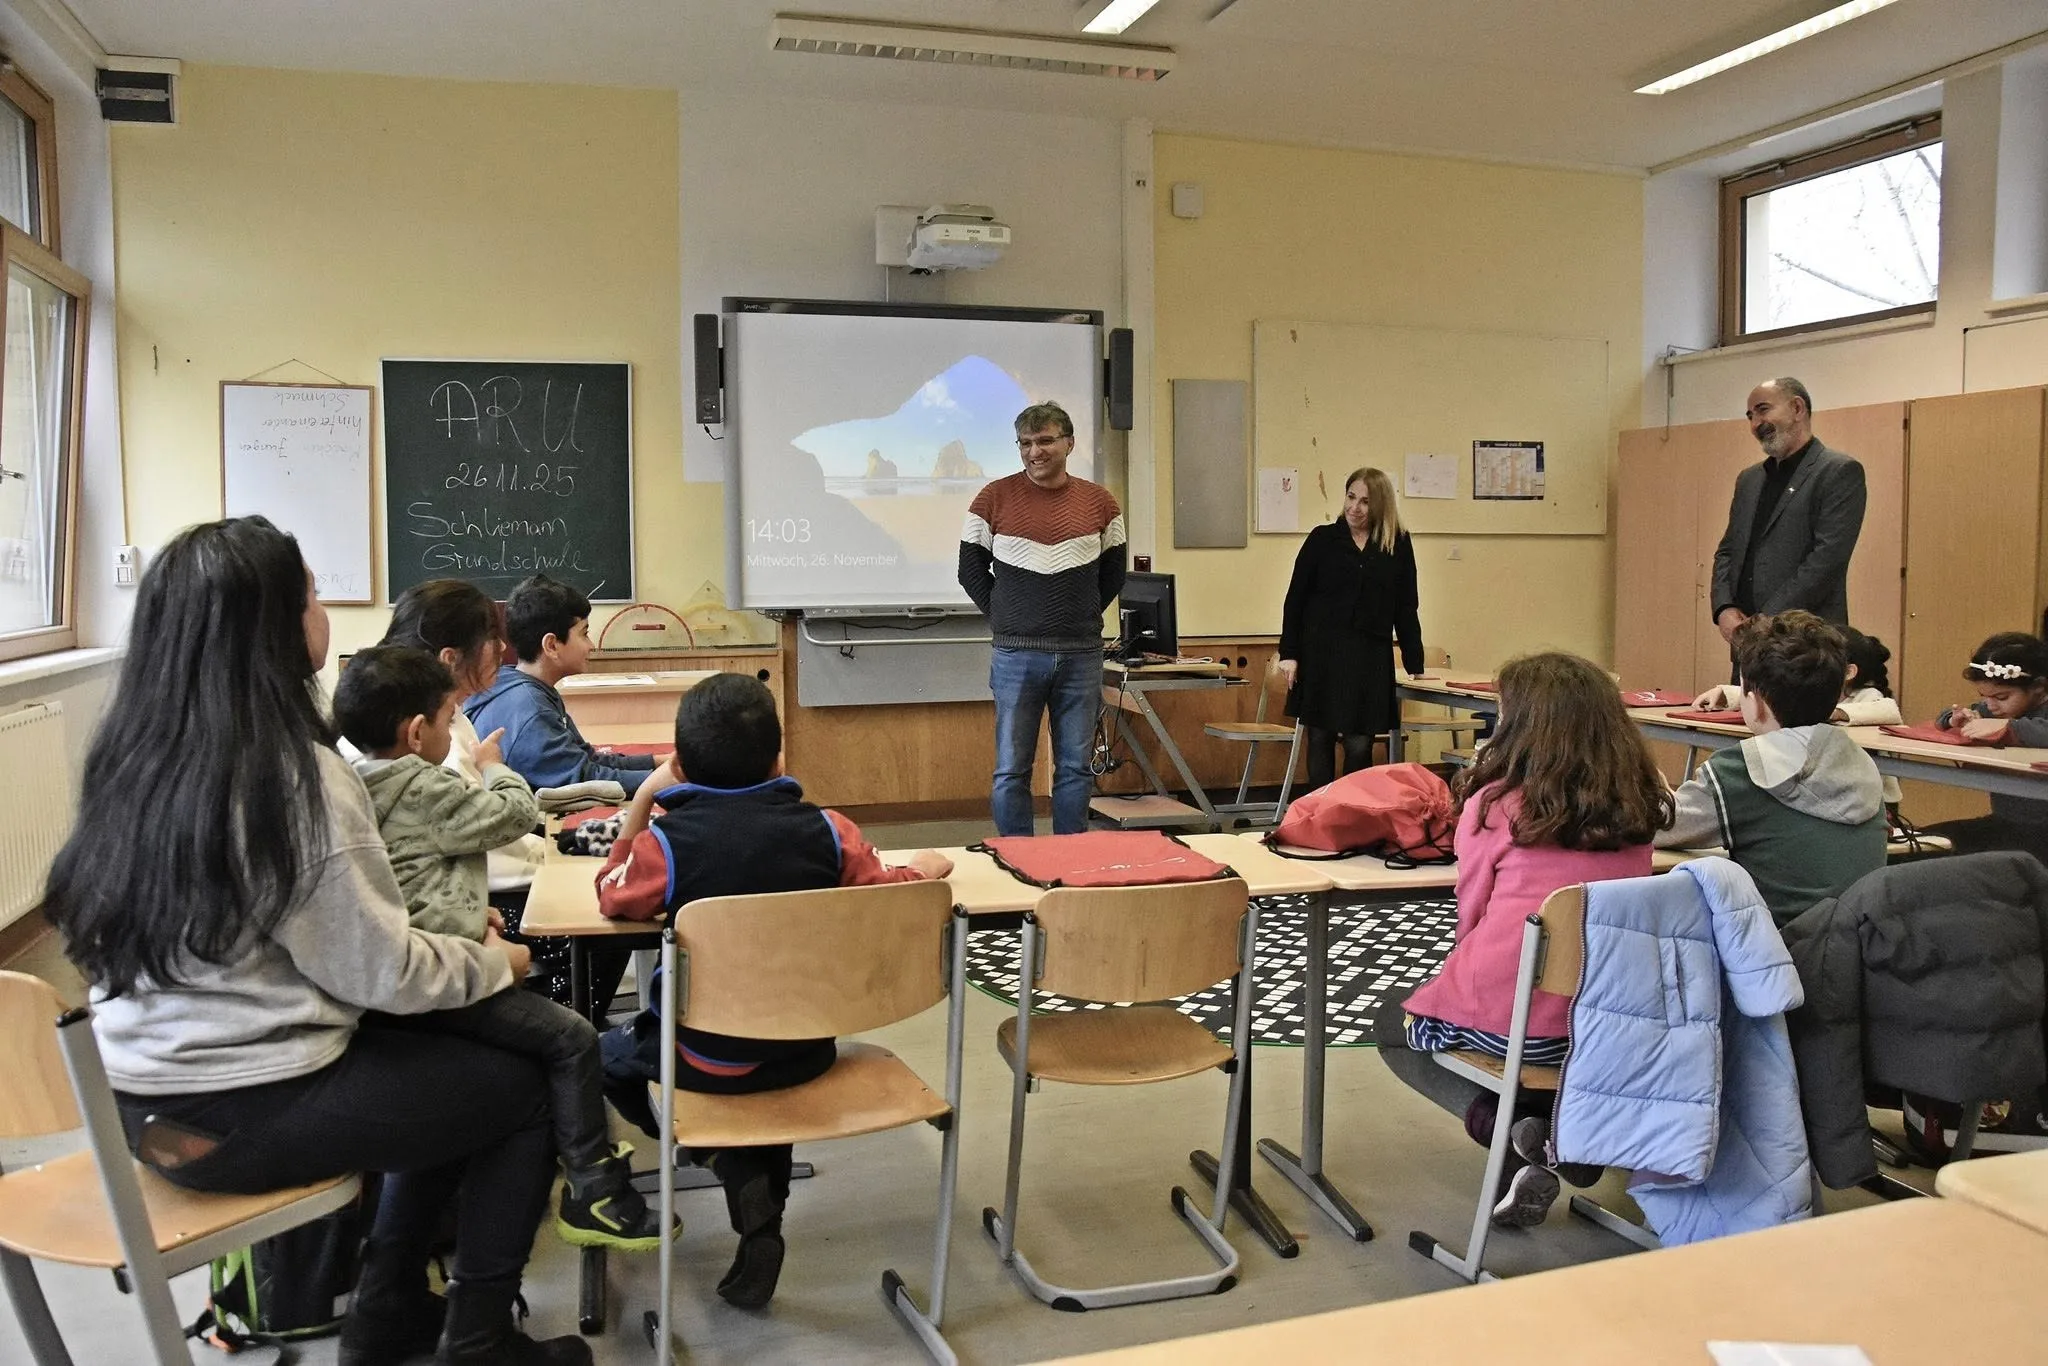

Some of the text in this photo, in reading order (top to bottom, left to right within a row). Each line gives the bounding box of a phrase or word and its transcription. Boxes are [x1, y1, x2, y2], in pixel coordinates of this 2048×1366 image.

[407, 501, 569, 538] Schliemann
[747, 518, 812, 543] 14:03
[421, 540, 591, 572] Grundschule
[747, 553, 898, 568] Mittwoch, 26. November
